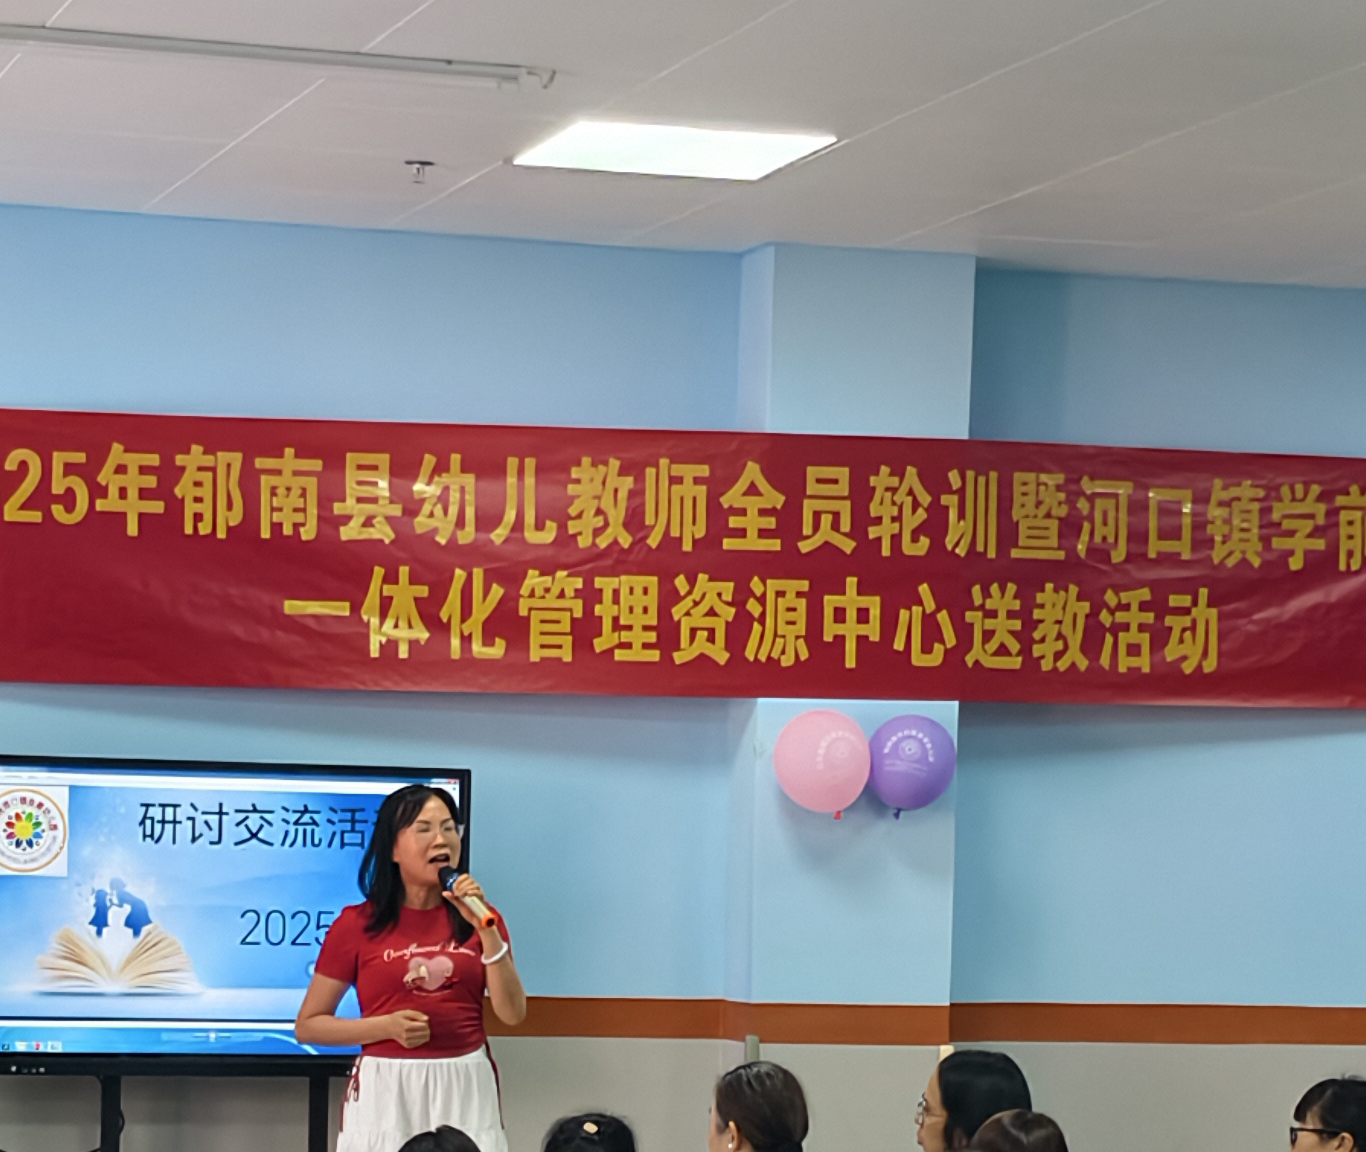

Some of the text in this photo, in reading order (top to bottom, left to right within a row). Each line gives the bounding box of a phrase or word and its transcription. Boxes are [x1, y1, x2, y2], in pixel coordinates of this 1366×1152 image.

[283, 564, 1220, 674] 一体化管理资源中心送教活动
[138, 801, 379, 850] 研讨交流活
